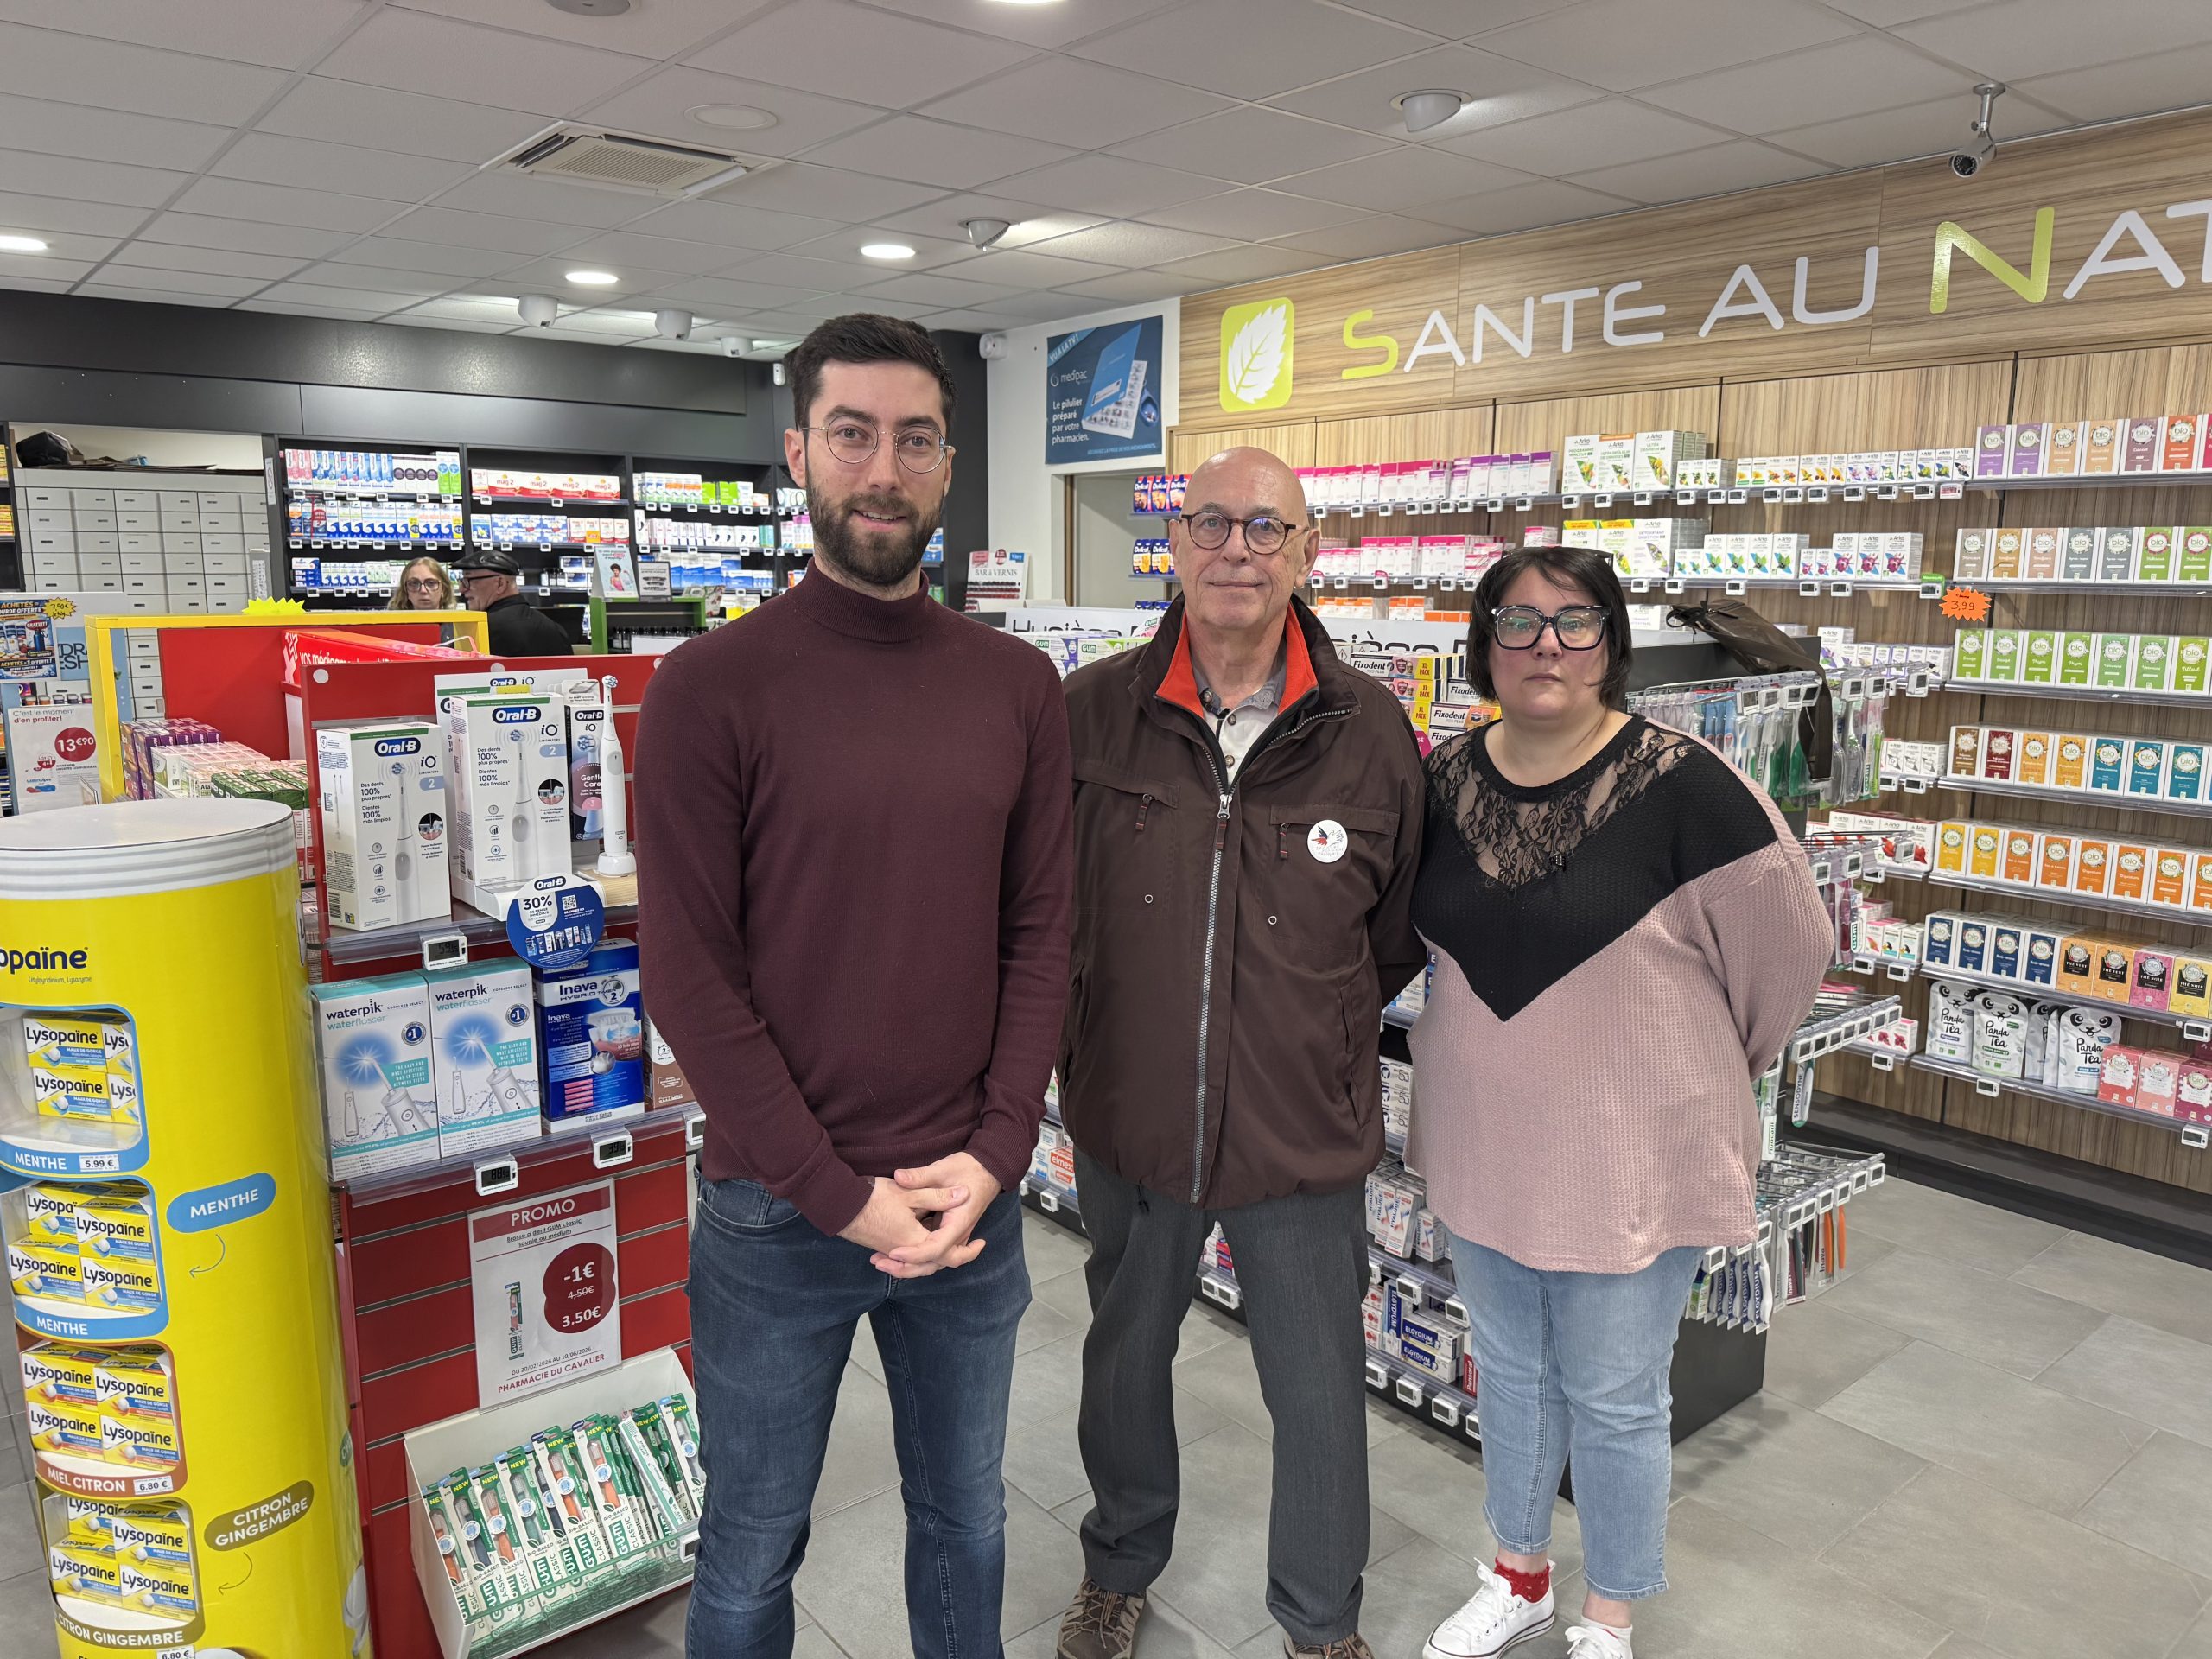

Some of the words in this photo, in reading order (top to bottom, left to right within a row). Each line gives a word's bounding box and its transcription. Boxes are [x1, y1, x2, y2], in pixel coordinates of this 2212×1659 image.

[1341, 280, 1668, 381] SANTE
[1698, 245, 1879, 338] AU
[1060, 370, 1087, 385] medipac
[1052, 401, 1060, 410] Le
[1061, 398, 1083, 411] pilulier
[1052, 411, 1077, 423] préparé
[1052, 423, 1063, 434] par
[1065, 422, 1080, 432] votre
[1052, 434, 1090, 446] pharmacien.
[1082, 645, 1096, 653] GUM
[1353, 660, 1386, 671] Fixodent
[495, 709, 538, 721] Oral-B
[1434, 710, 1465, 719] Fixodent
[541, 724, 558, 736] iO
[585, 722, 596, 731] iO
[378, 740, 416, 754] Oral-B
[550, 747, 556, 755] 2
[420, 755, 436, 768] iO
[477, 752, 498, 760] 100%
[429, 778, 435, 788] 2
[363, 810, 380, 819] 100%
[536, 878, 563, 889] Oral-B
[524, 895, 553, 911] 30%
[435, 982, 488, 1001] waterpik
[559, 982, 598, 995] Inava
[560, 991, 596, 1001] HYBRID
[326, 999, 383, 1020] waterpik
[436, 997, 492, 1012] waterflosser
[327, 1014, 387, 1031] waterflosser
[1941, 1007, 1965, 1024] Panda
[26, 1027, 98, 1046] Lysopaïne
[1944, 1023, 1962, 1035] Tea
[1985, 1021, 2009, 1037] Panda
[1988, 1036, 2008, 1047] Tea
[2077, 1038, 2103, 1052] Panda
[2081, 1052, 2101, 1065] Tea
[35, 1075, 103, 1094] Lysopaïne
[1794, 1073, 1802, 1118] SENSODYNE
[15, 1151, 67, 1170] MENTHE
[85, 1160, 105, 1168] 5.99
[189, 1189, 259, 1219] MENTHE
[1390, 1196, 1401, 1228] HYALUGEL
[511, 1199, 575, 1227] PROMO
[76, 1217, 145, 1237] Lysopaïne
[506, 1234, 525, 1243] Brosse
[547, 1224, 562, 1232] GUM
[562, 1218, 582, 1228] classic
[518, 1239, 537, 1248] souple
[10, 1255, 77, 1277] Lysopaïne
[563, 1262, 595, 1282] -1€
[83, 1267, 153, 1287] Lysopaïne
[567, 1286, 594, 1300] 4,50€
[562, 1306, 601, 1327] 3.50€
[36, 1315, 88, 1336] MENTHE
[1405, 1325, 1433, 1343] ELGYDIUM
[521, 1357, 551, 1374] 20/02/2026
[562, 1346, 591, 1360] 10/06/2026
[1403, 1346, 1431, 1363] ELGYDIUM
[24, 1363, 92, 1384] Lysopaïne
[498, 1371, 550, 1393] PHARMACIE
[550, 1365, 563, 1376] DU
[564, 1353, 605, 1373] CAVALIER
[96, 1376, 164, 1398] Lysopaïne
[31, 1410, 97, 1434] Lysopaïne
[588, 1425, 602, 1436] NEW
[548, 1438, 563, 1448] NEW
[510, 1459, 526, 1469] NEW
[48, 1467, 71, 1486] MIEL
[73, 1476, 126, 1492] CITRON
[140, 1482, 159, 1491] 6.80
[453, 1479, 469, 1492] NEW
[233, 1493, 292, 1526] CITRON
[603, 1505, 629, 1522] BIO-BASED
[214, 1498, 308, 1547] GINGEMBRE
[569, 1519, 594, 1535] BIO-BASED
[527, 1541, 554, 1557] BIO-BASED
[474, 1562, 500, 1581] BIO-BASED
[59, 1612, 91, 1642] CITRON
[93, 1631, 184, 1646] GINGEMBRE
